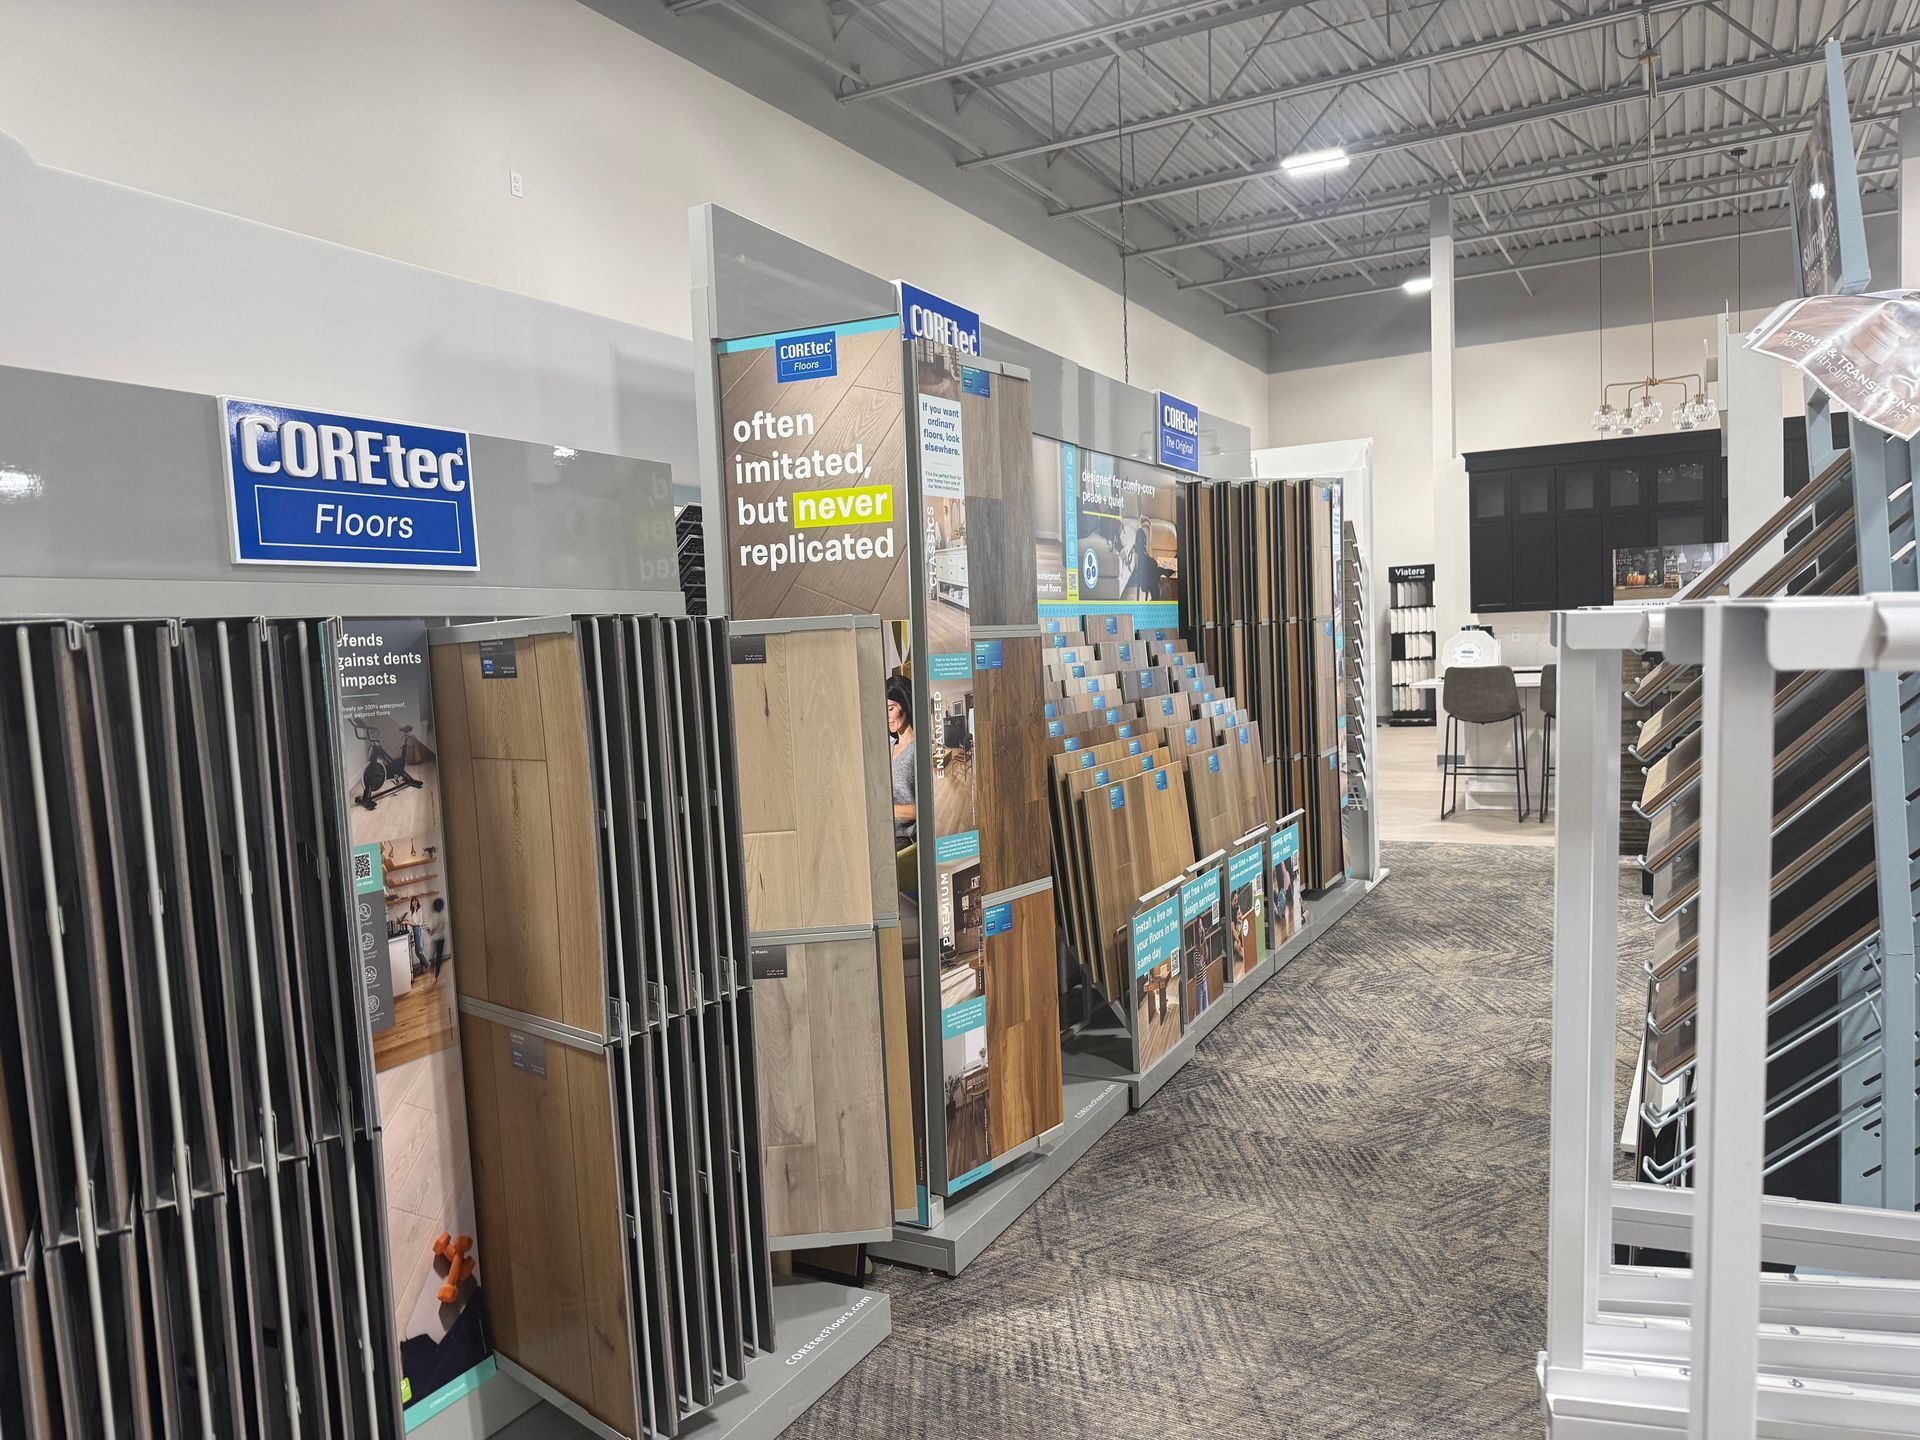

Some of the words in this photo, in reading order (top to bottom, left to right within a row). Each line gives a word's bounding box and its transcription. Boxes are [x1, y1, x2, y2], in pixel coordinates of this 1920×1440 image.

[780, 341, 832, 359] COREtec
[1780, 337, 1796, 350] for
[1827, 347, 1838, 359] &
[794, 361, 819, 371] Floors
[922, 402, 928, 411] If
[929, 405, 941, 415] you
[942, 408, 960, 418] want
[733, 410, 814, 443] often
[927, 418, 955, 431] ordinary
[1164, 405, 1197, 436] COREtec
[923, 428, 945, 442] floors,
[946, 433, 960, 443] look
[1166, 435, 1175, 448] The
[1175, 439, 1194, 455] Original
[925, 442, 960, 456] elsewhere.
[735, 444, 872, 484] imitated,
[1081, 467, 1111, 488] designed
[1112, 474, 1121, 488] for
[1122, 479, 1156, 498] comfy-cozy
[737, 496, 788, 526] but
[799, 491, 888, 521] never
[1082, 491, 1102, 504] peace
[1108, 494, 1124, 508] quiet
[315, 503, 414, 539] Floors
[739, 528, 894, 572] replicated
[927, 505, 938, 587] CLASSICS
[1394, 567, 1425, 576] Viatera
[1049, 583, 1061, 592] floors
[383, 652, 422, 666] dents
[341, 673, 397, 690] impacts
[934, 690, 945, 779] ENHANCED
[1238, 858, 1246, 868] time
[1249, 851, 1259, 862] money
[1191, 885, 1200, 898] free
[1203, 873, 1217, 889] virtual
[941, 872, 951, 947] PREMIUM
[1184, 901, 1198, 917] design
[1135, 915, 1152, 936] install
[1152, 917, 1156, 925] +
[1156, 910, 1166, 923] live
[1166, 906, 1173, 917] on
[1136, 937, 1148, 955] your
[1149, 928, 1164, 945] floors
[1164, 923, 1170, 936] in
[1170, 919, 1178, 932] the
[1137, 953, 1151, 970] same
[1152, 946, 1162, 960] day
[785, 1295, 873, 1366] COREtecFloors.com
